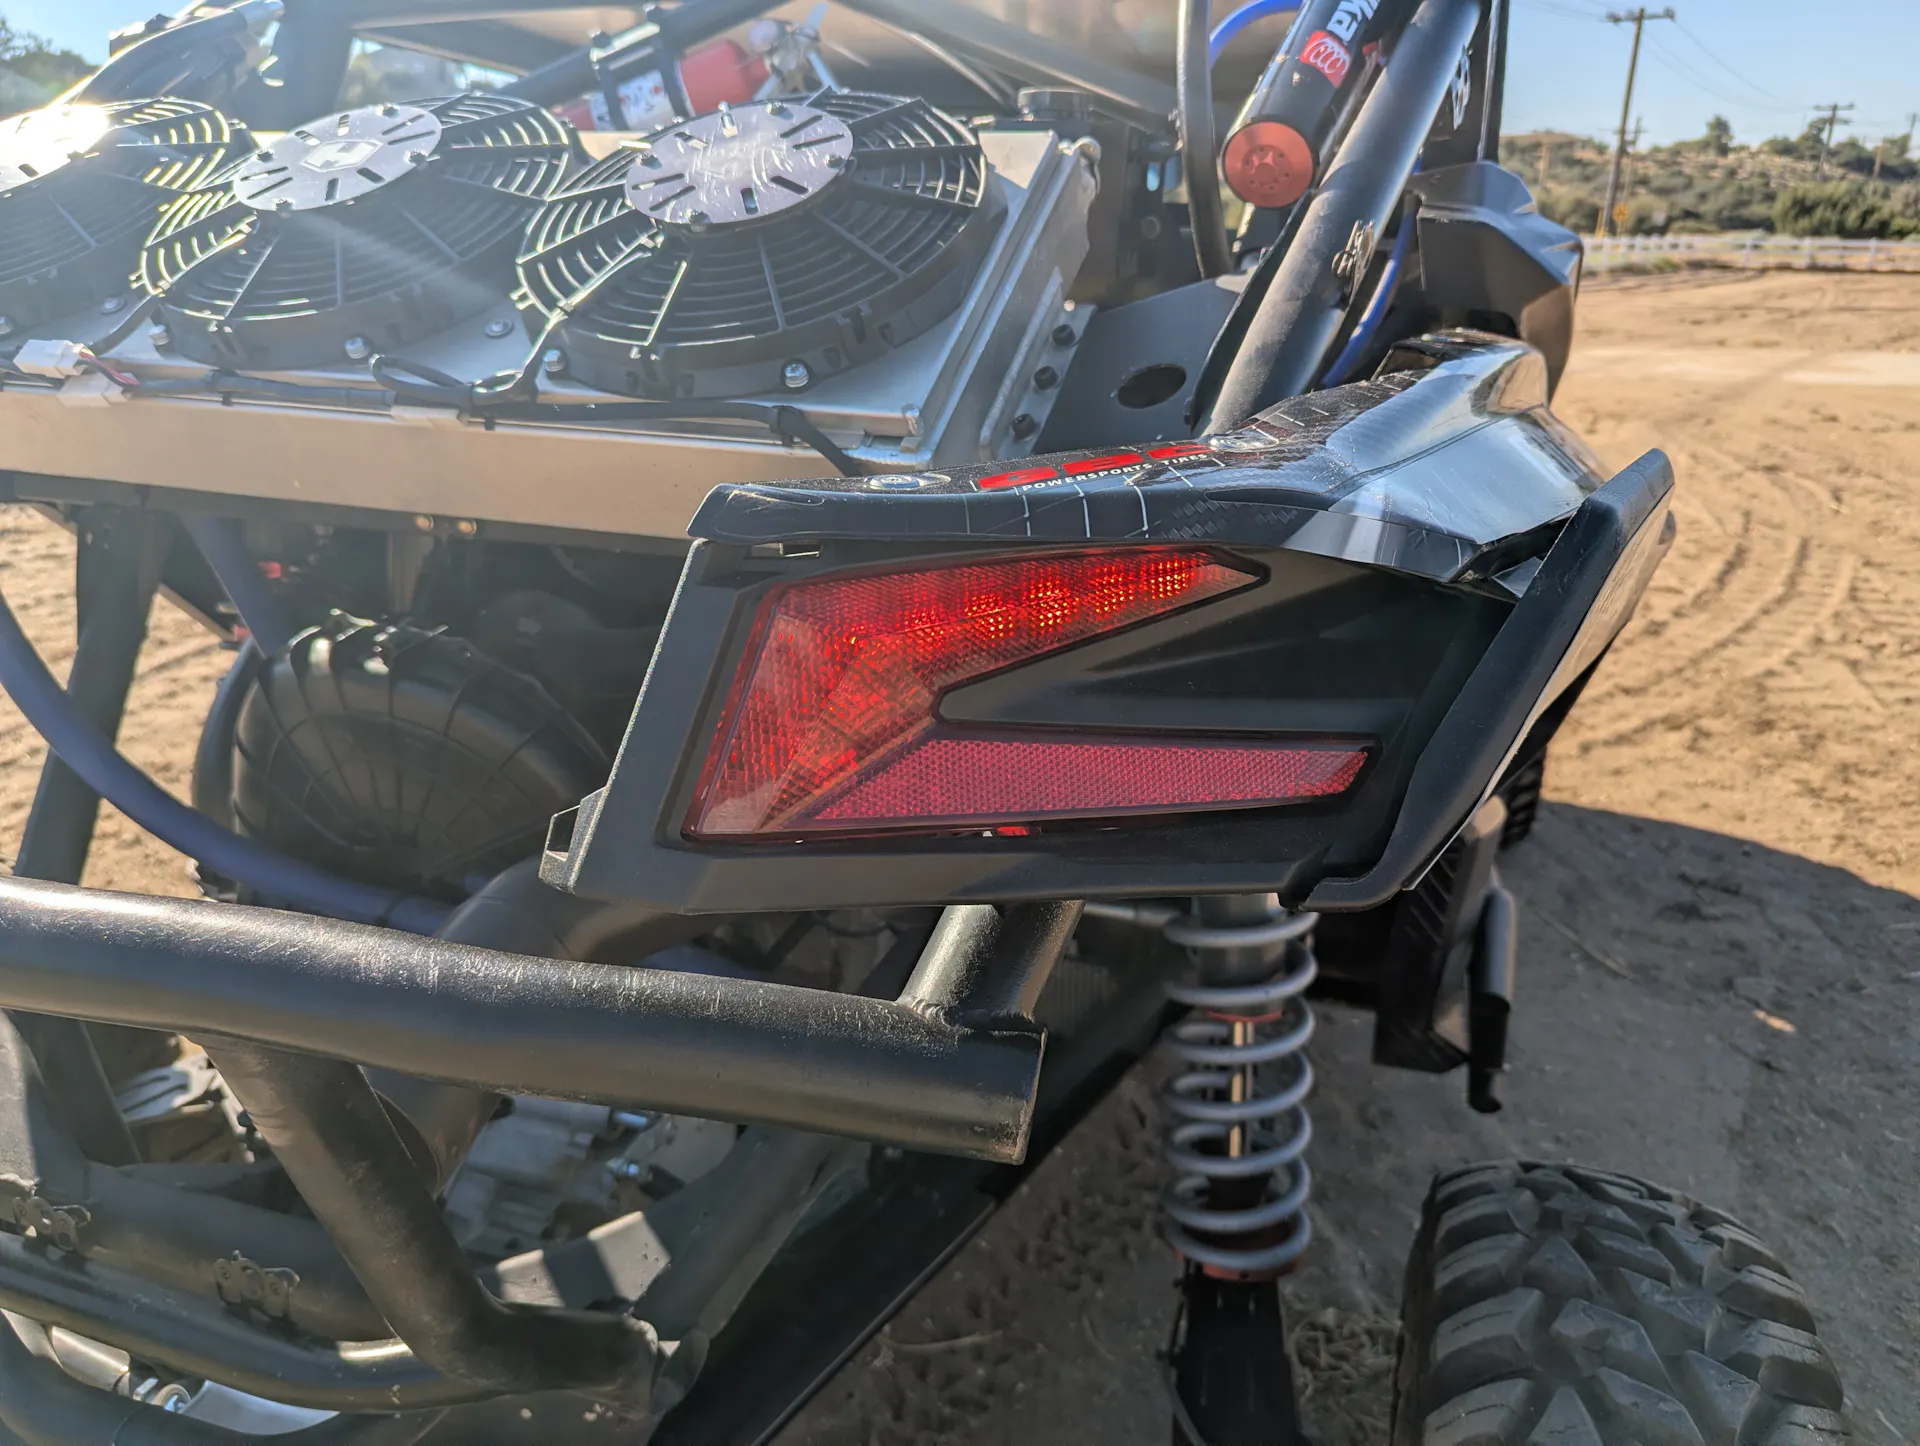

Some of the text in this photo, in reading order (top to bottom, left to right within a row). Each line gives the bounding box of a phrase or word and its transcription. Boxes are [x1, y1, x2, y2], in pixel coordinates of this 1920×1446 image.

[1326, 0, 1379, 42] ka
[1022, 453, 1208, 492] POWERSPORTS TIRES
